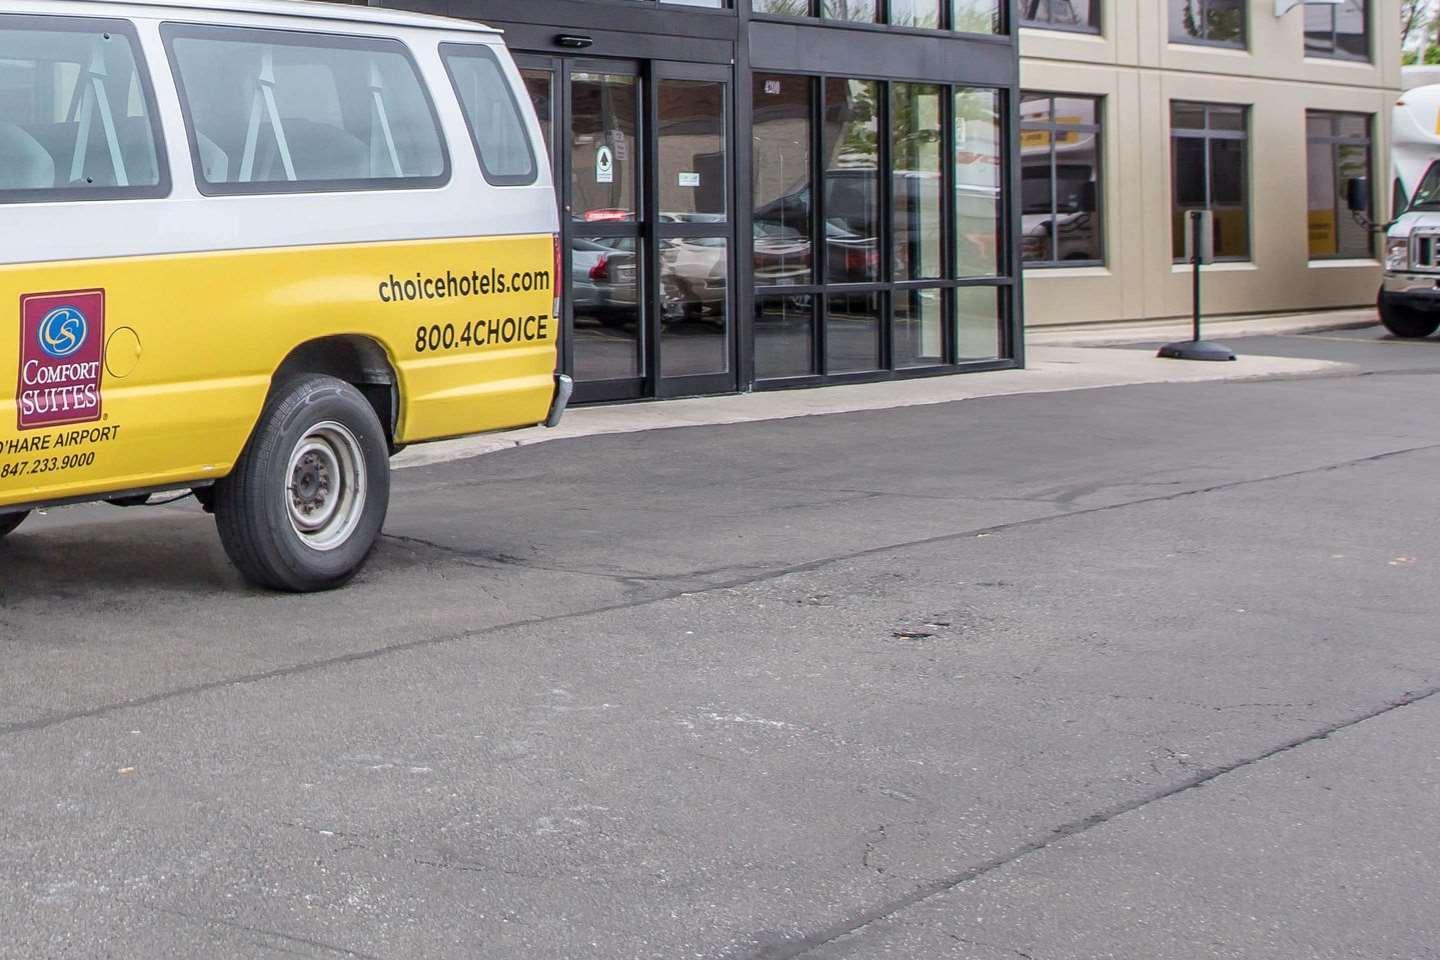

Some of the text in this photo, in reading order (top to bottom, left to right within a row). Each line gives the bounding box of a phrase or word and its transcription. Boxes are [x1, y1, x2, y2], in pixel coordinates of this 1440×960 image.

[378, 267, 550, 303] choicehotels.com
[415, 314, 549, 353] 800.4CHOICE
[23, 383, 97, 415] SUITES
[53, 425, 121, 449] AIRPORT
[1, 451, 95, 478] 847.233.9000
